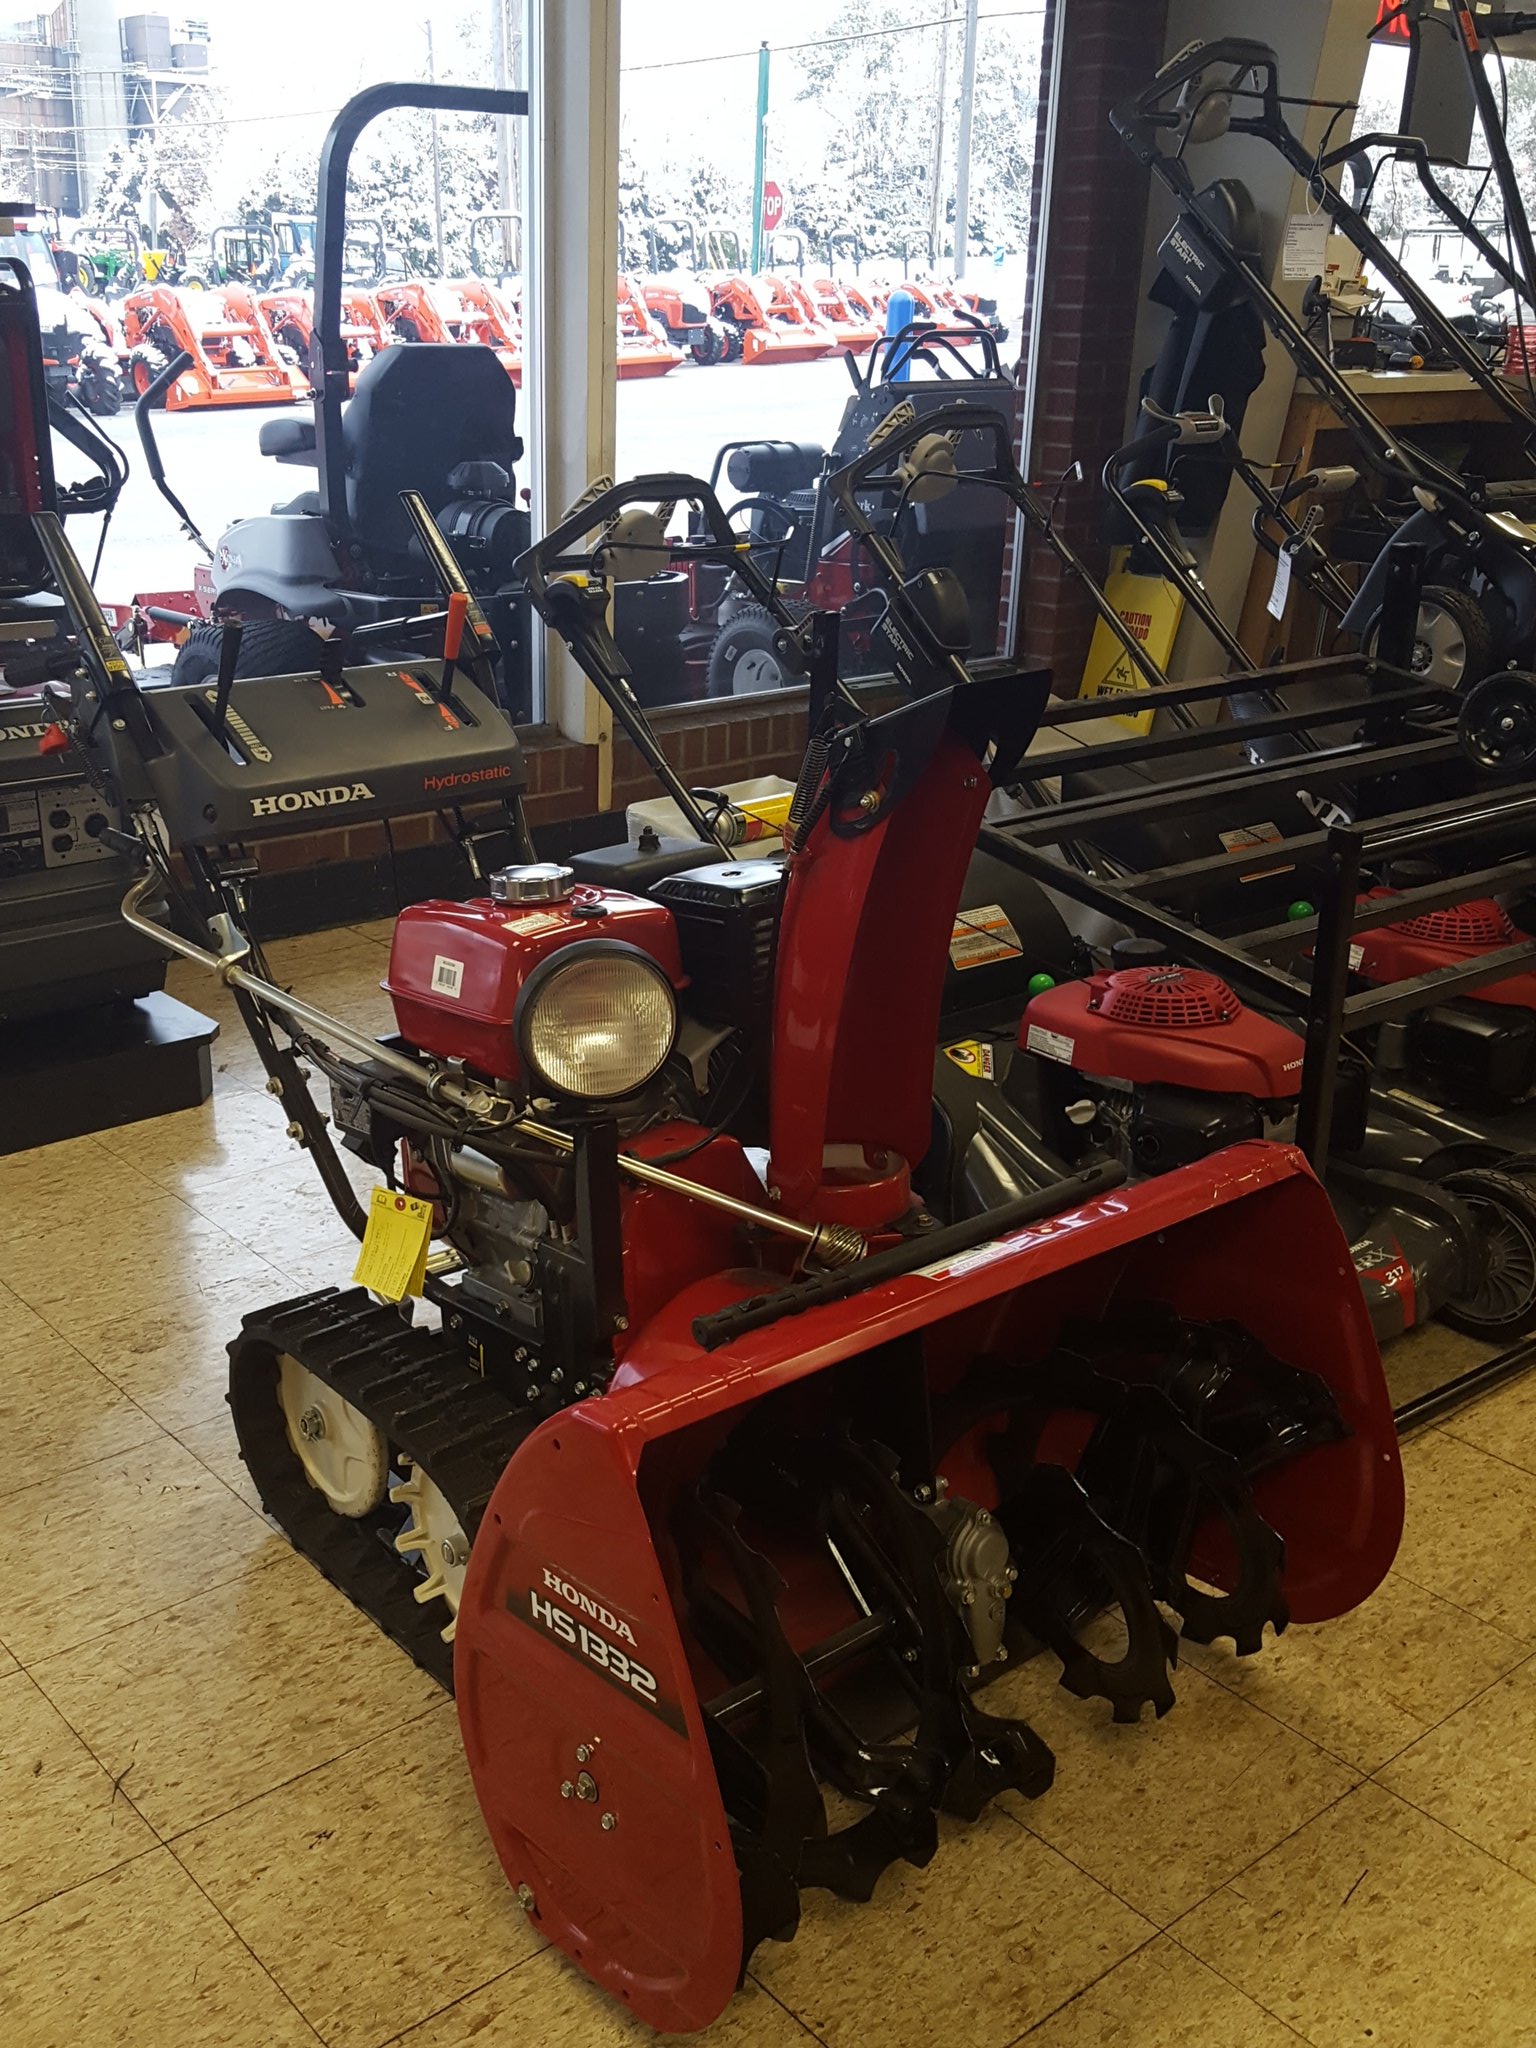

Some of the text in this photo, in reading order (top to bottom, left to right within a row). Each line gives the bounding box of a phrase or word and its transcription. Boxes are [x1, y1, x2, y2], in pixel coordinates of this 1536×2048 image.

[764, 196, 782, 216] OP
[1170, 237, 1192, 264] START
[1174, 231, 1205, 270] ELECTRIC
[1120, 610, 1153, 628] CAUTION
[881, 622, 902, 651] START
[885, 616, 914, 661] ELECTRIC
[424, 765, 511, 792] Hydrostatic
[250, 783, 375, 817] HONDA
[1282, 1058, 1304, 1072] HON
[1385, 1265, 1404, 1280] 217
[542, 1567, 638, 1647] HONDA
[530, 1590, 657, 1704] HS1332
